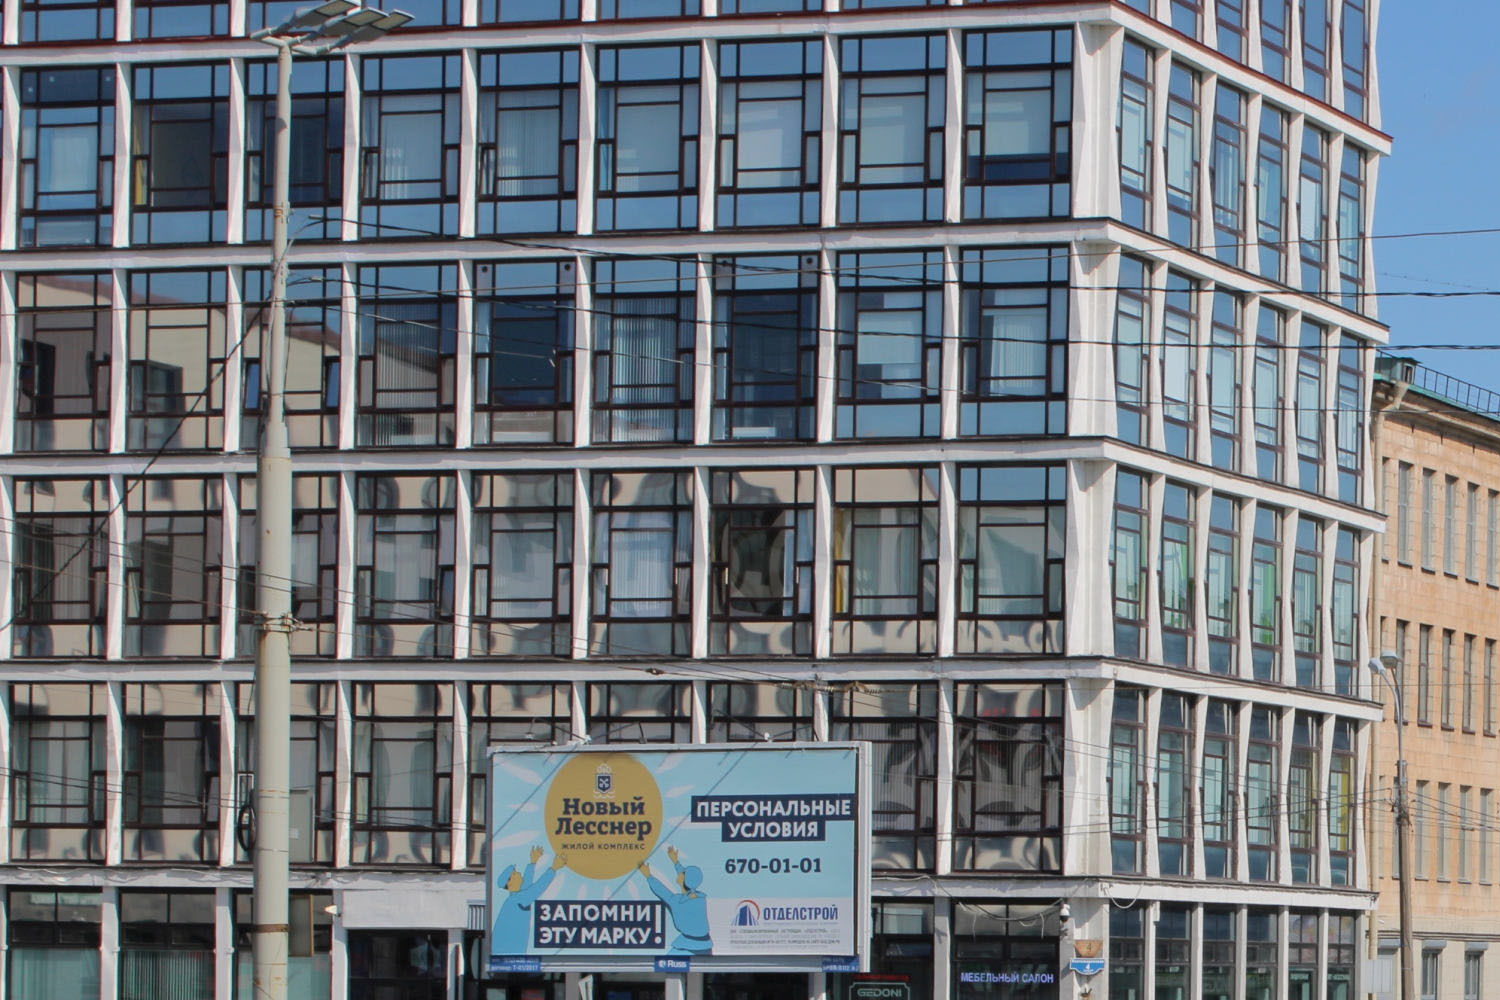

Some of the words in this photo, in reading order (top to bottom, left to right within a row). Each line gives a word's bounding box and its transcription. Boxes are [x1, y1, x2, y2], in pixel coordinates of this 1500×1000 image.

[562, 796, 645, 815] Новый
[697, 800, 851, 817] ПЕРСОНАЛЬНЫЕ
[555, 817, 652, 841] Лесснер
[728, 821, 818, 838] УСЛОВИЯ
[562, 841, 594, 850] ЖИЛОЙ
[598, 842, 646, 850] КОМПЛЕКС
[725, 857, 822, 874] 670-01-01
[540, 904, 651, 921] ЗАПОМНИ
[763, 904, 838, 920] ОТДЕЛСТРОЙ
[539, 927, 577, 944] ЭТУ
[581, 927, 652, 944] МАРКУ
[667, 960, 687, 968] Russ
[961, 972, 1019, 983] МЕБЕЛЬНЫЙ
[1022, 973, 1054, 983] САЛОН
[857, 988, 902, 997] GEDONI
